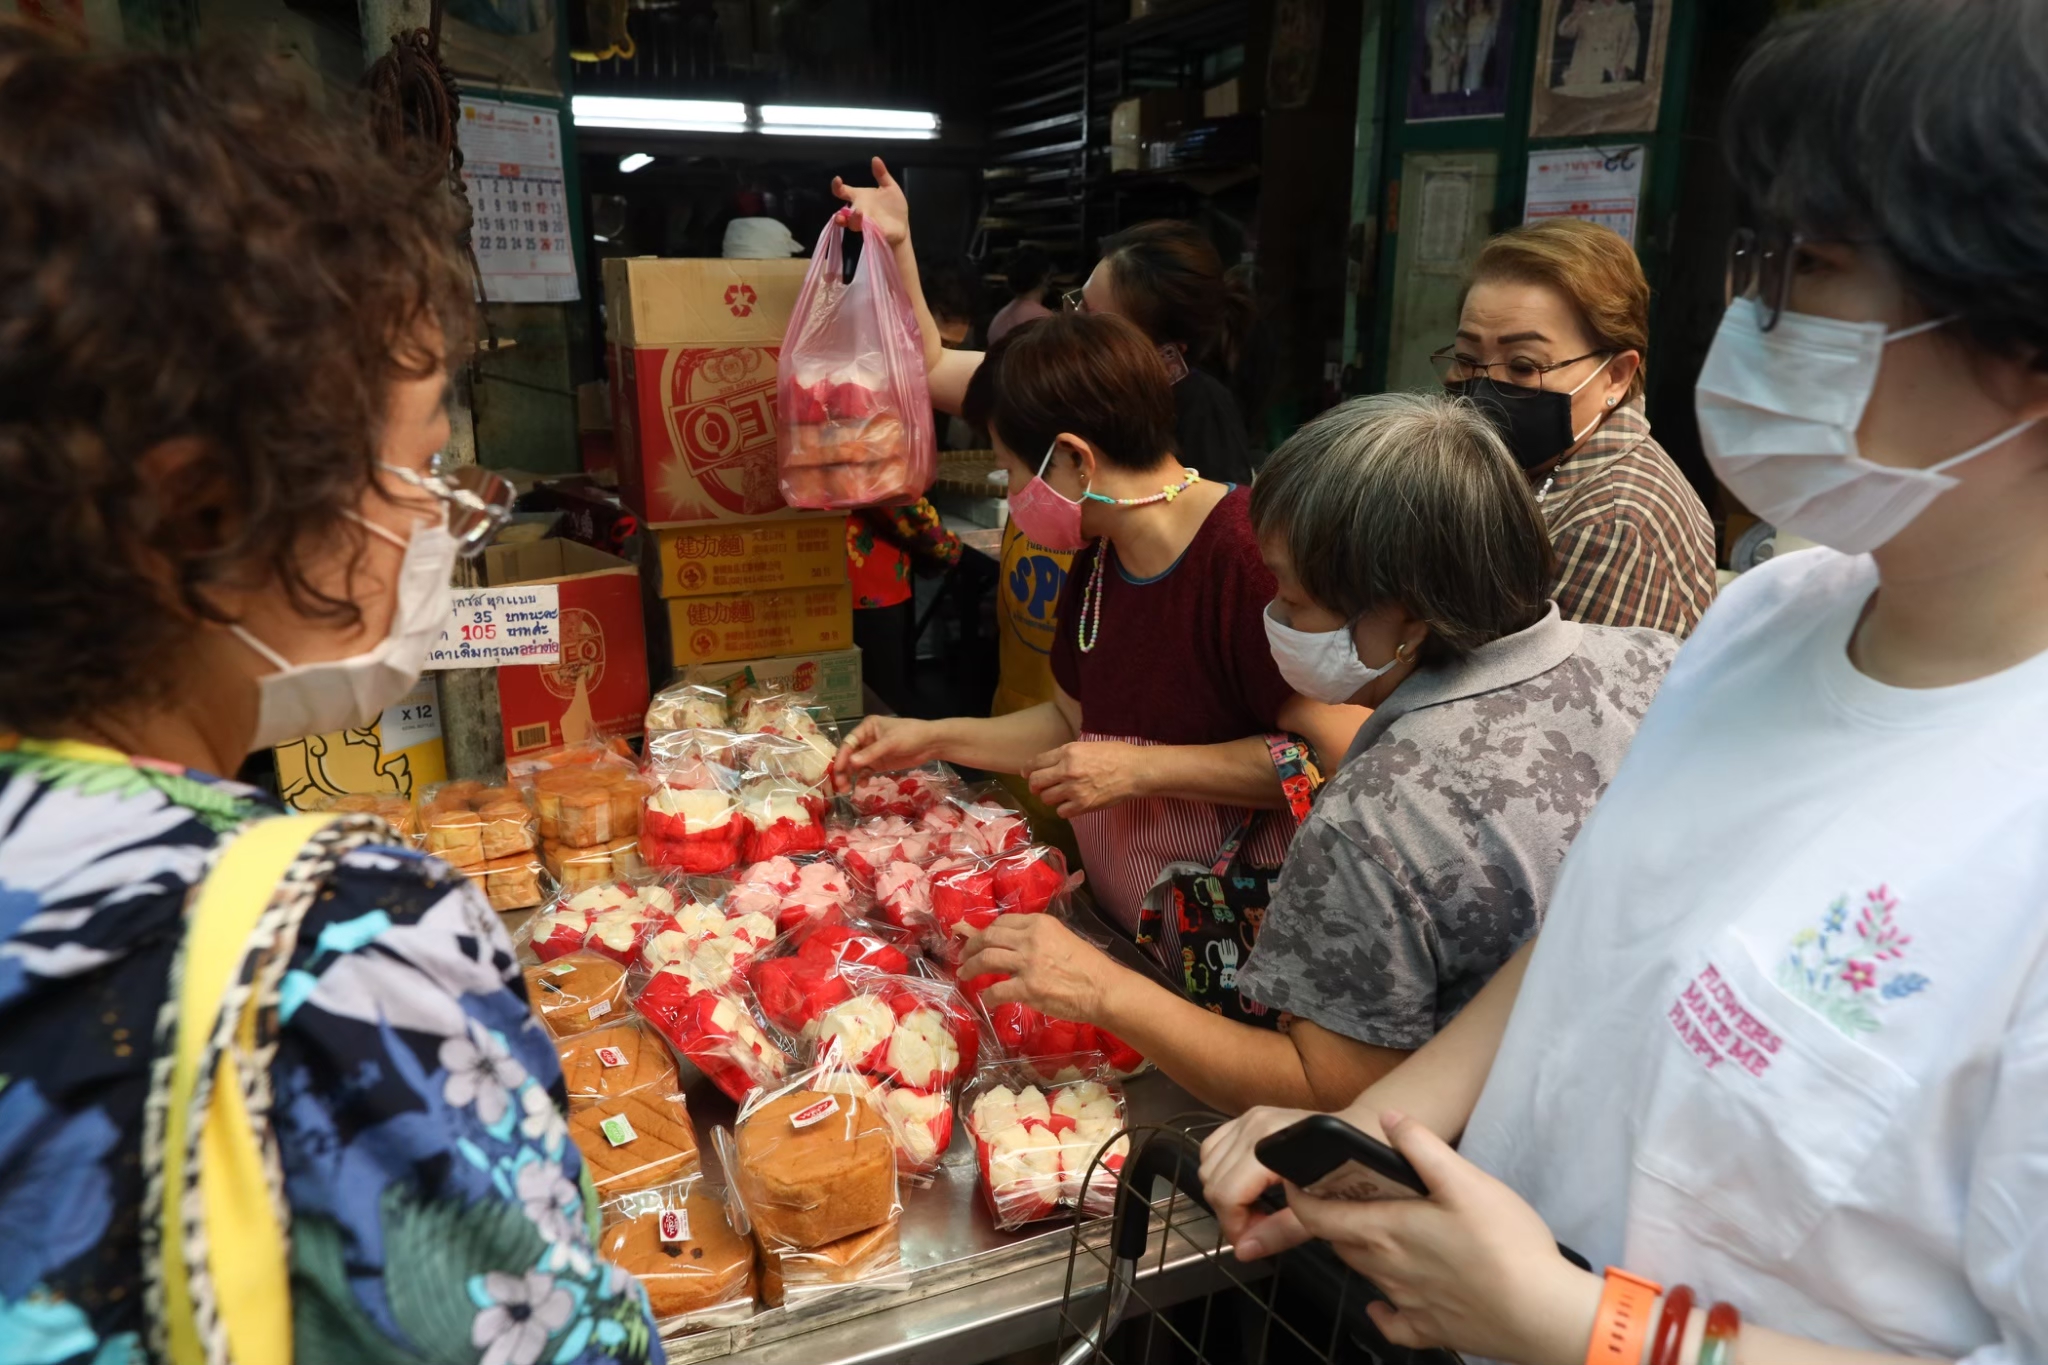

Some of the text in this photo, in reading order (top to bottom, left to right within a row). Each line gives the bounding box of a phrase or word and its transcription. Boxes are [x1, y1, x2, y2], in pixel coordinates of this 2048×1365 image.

[478, 198, 485, 212] 8
[494, 198, 501, 212] 9
[507, 199, 518, 213] 10
[522, 200, 531, 213] 11
[478, 217, 490, 231] 15
[494, 218, 505, 231] 16
[509, 218, 520, 231] 17
[523, 219, 534, 232] 18
[480, 236, 491, 250] 22
[495, 236, 508, 250] 23
[511, 236, 522, 250] 24
[525, 237, 536, 251] 25
[682, 388, 783, 463] EO
[473, 610, 493, 624] 35
[461, 624, 498, 641] 105
[416, 705, 433, 719] 12
[1699, 962, 1784, 1055] FLOWERS
[1668, 999, 1726, 1069] HAPPY
[1681, 979, 1772, 1078] MAKE ME
